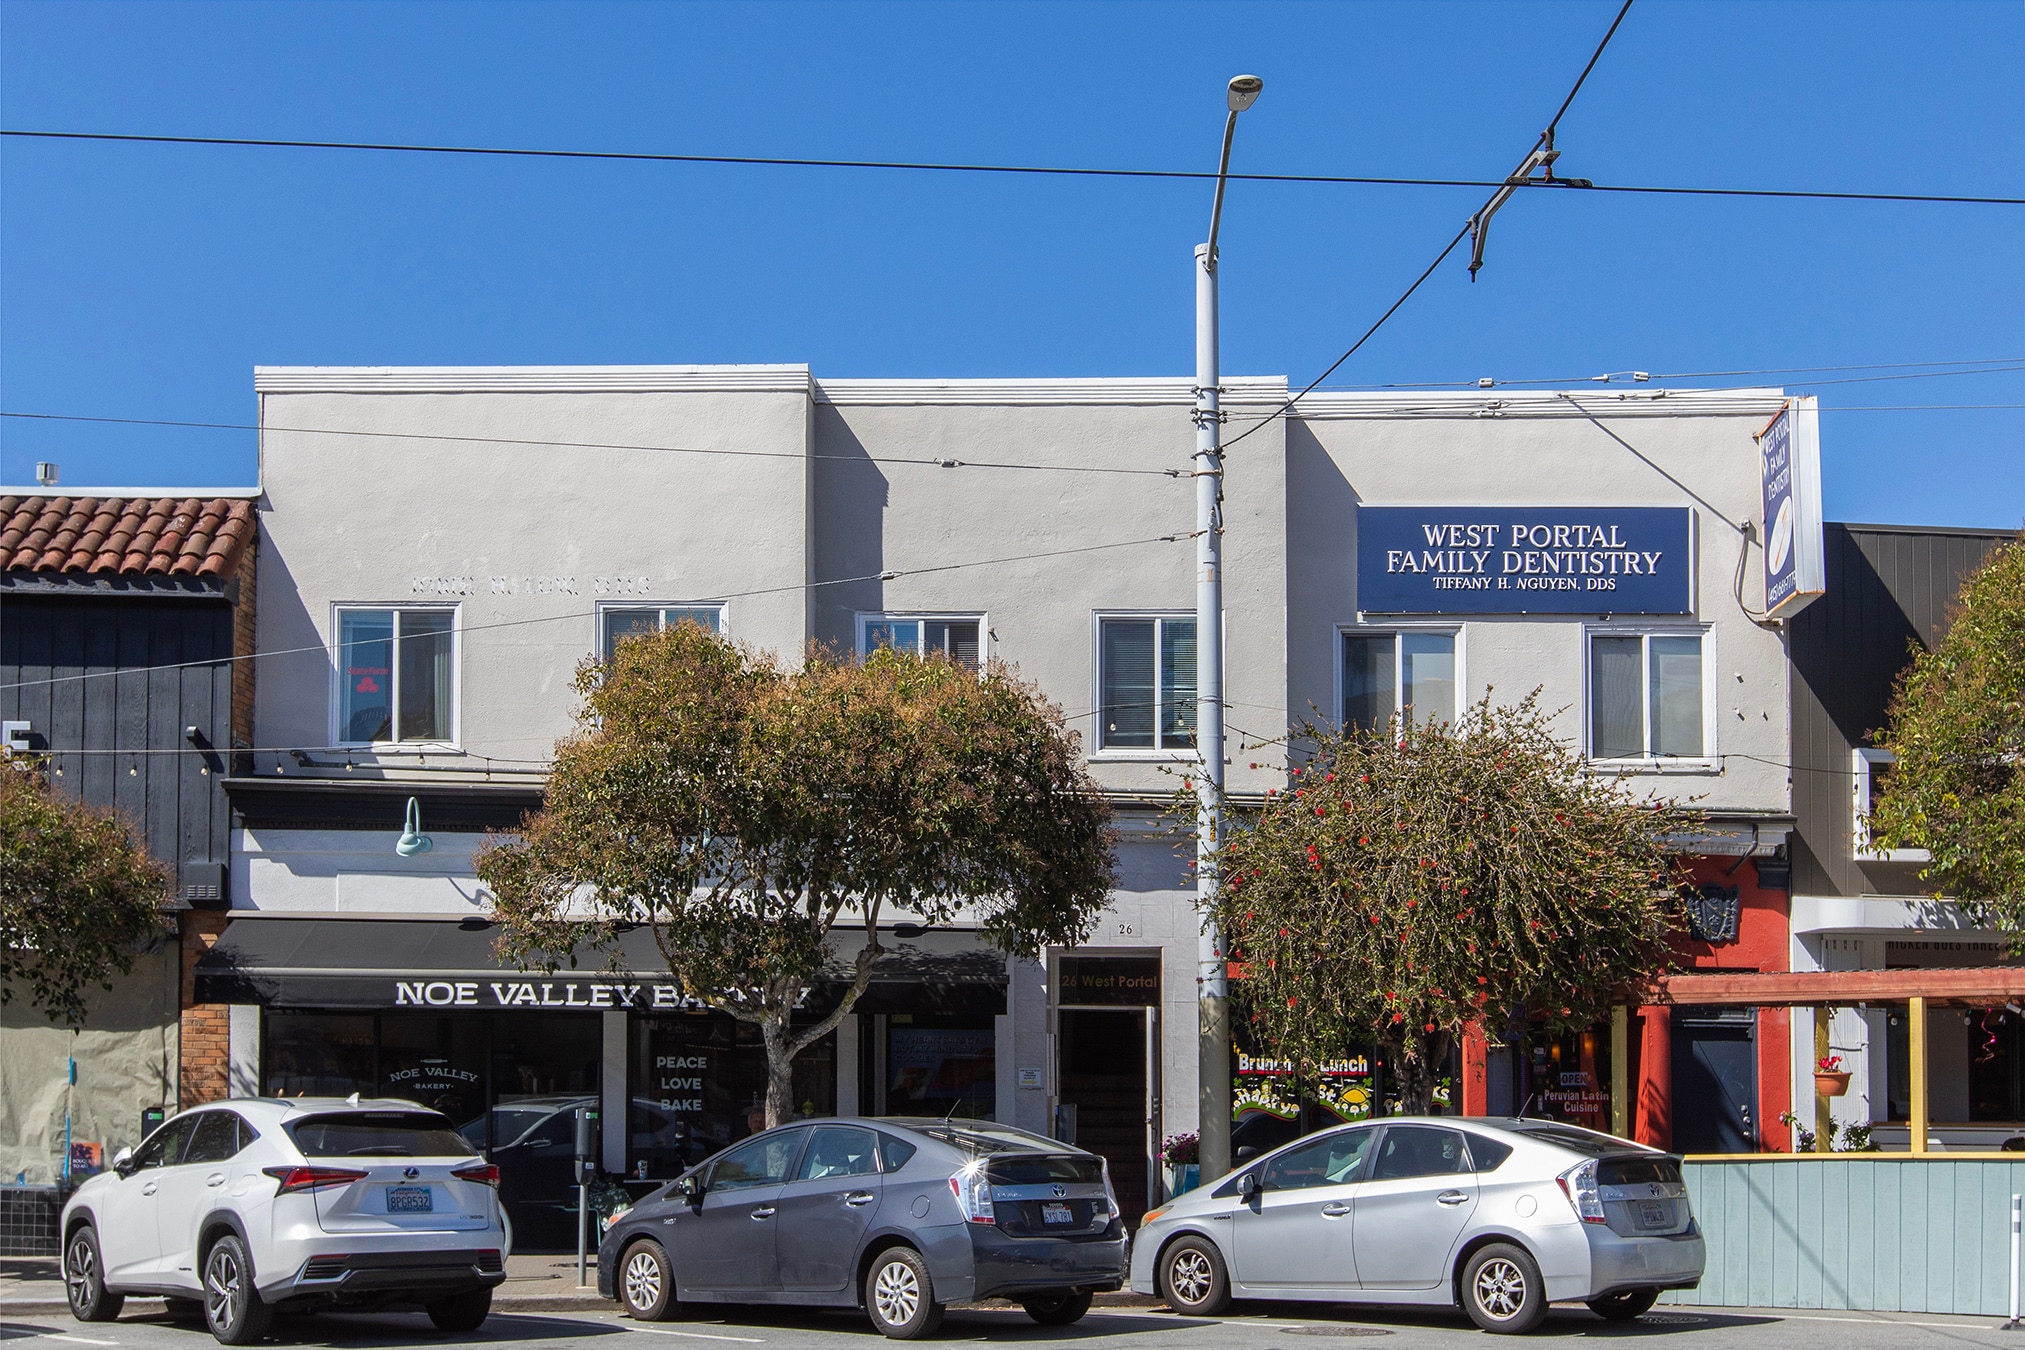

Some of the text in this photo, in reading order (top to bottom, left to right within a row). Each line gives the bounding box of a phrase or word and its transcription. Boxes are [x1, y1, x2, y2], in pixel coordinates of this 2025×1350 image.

[1769, 443, 1786, 475] FAMILY
[1767, 464, 1790, 501] DENTISTRY
[1422, 524, 1627, 549] WEST PORTAL
[1387, 551, 1662, 575] FAMILY DENTISTRY
[1433, 577, 1492, 590] TIFFANY
[1498, 578, 1511, 590] H.
[1587, 578, 1617, 590] DDS
[1118, 923, 1133, 935] 26
[1061, 974, 1158, 989] 26 West Portal
[396, 982, 478, 1006] NOE
[490, 983, 637, 1008] VALLEY
[656, 1056, 707, 1069] PEACE
[1238, 1053, 1369, 1076] Brunch Lunch
[390, 1066, 478, 1082] NOE VALLEY
[1561, 1073, 1588, 1084] OPEN
[661, 1077, 702, 1090] LOVE
[1544, 1089, 1610, 1101] Peruvian Latin
[661, 1099, 703, 1111] BAKE
[1563, 1101, 1599, 1113] Cuisine
[390, 1196, 429, 1208] 8PGR532
